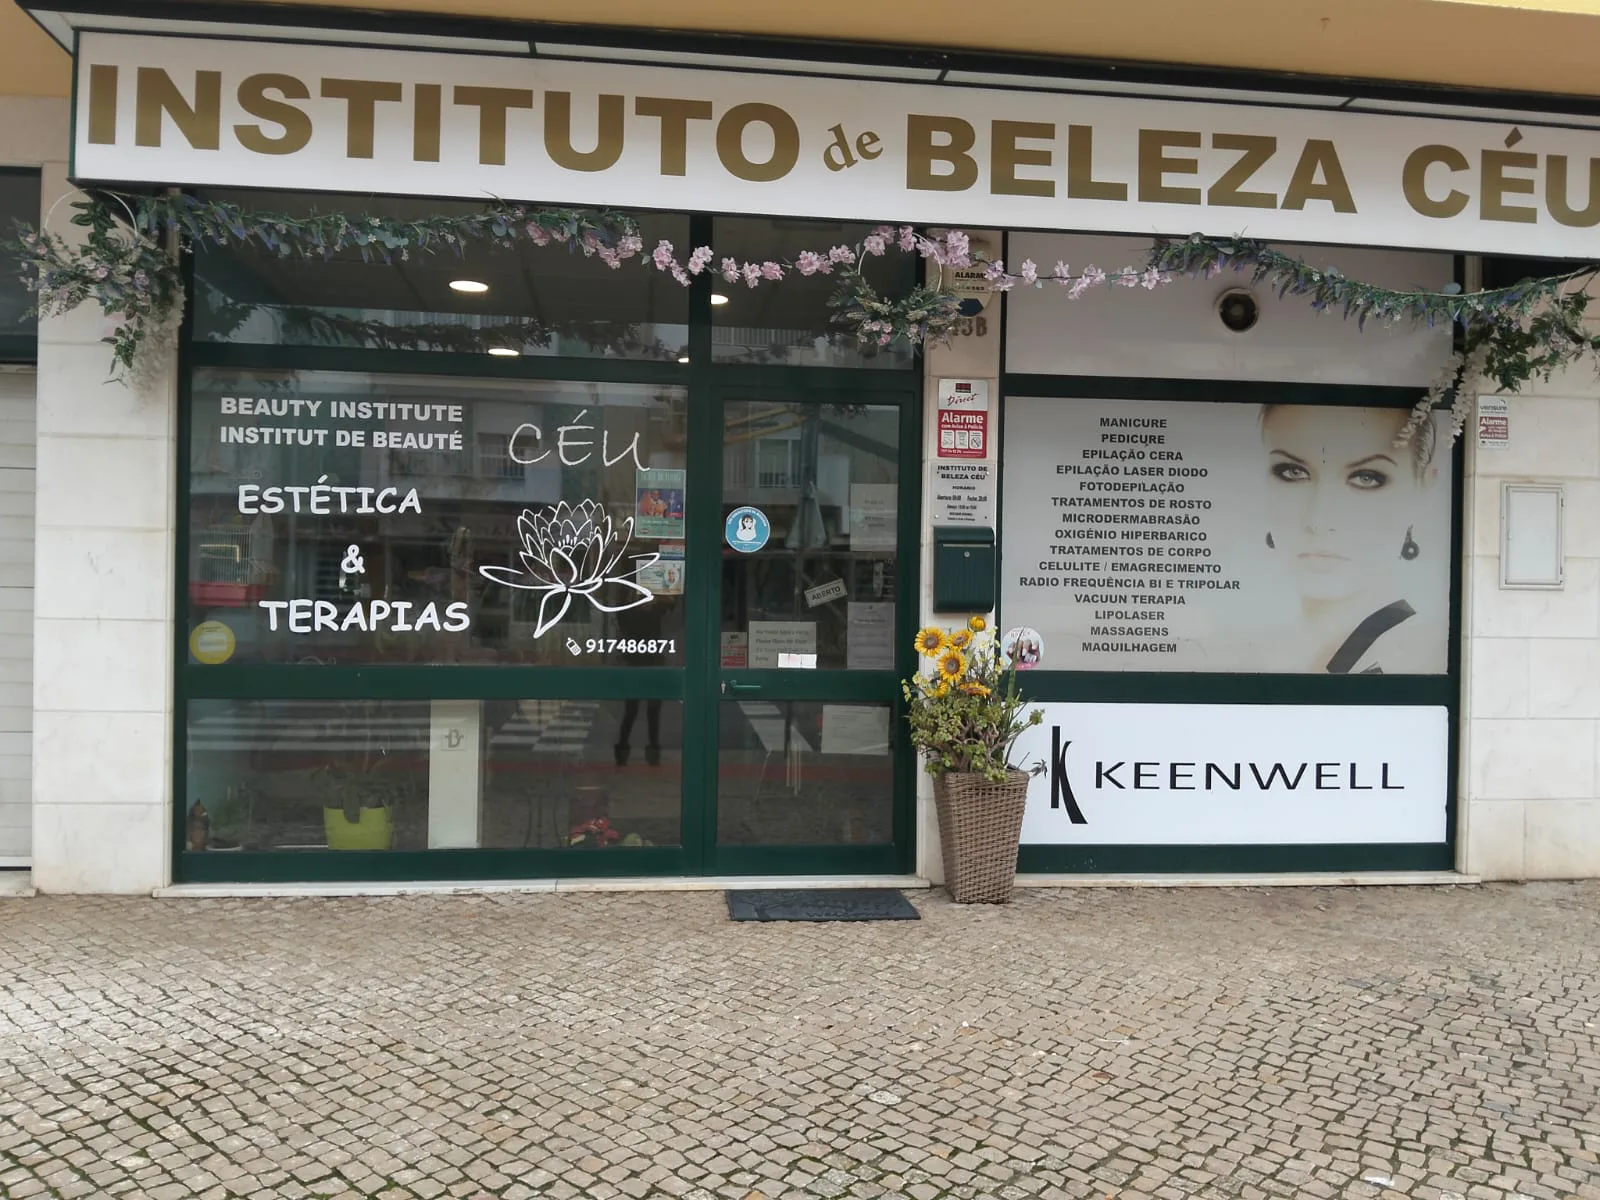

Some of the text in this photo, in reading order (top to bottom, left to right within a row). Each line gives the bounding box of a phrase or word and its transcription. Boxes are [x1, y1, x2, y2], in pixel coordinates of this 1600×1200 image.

[87, 63, 1600, 228] INSTITUTO de BELEZA CÉU
[221, 398, 463, 422] BEAUTY INSTITUTE
[942, 412, 983, 424] Alarme
[1100, 418, 1167, 428] MANICURE
[221, 426, 463, 450] INSTITUT DE BEAUTÉ
[508, 409, 650, 471] CÉU
[1102, 434, 1165, 444] PEDICURE
[1082, 450, 1183, 462] EPILAÇÃO CERA
[1056, 465, 1208, 477] EPILAÇÃO LASER DIODO
[1080, 482, 1184, 494] FOTODEPILAÇÃO
[238, 474, 422, 515] ESTÉTICA
[1052, 497, 1211, 509] TRATAMENTOS DE ROSTO
[1062, 513, 1200, 525] MICRODERMABRASÃO
[1055, 528, 1207, 541] OXIGÉNIO HIPERBARICO
[1050, 545, 1211, 557] TRATAMENTOS DE CORPO
[341, 545, 366, 574] &
[1039, 561, 1221, 573] CELULITE / EMAGRECIMENTO
[1020, 577, 1240, 590] RADIO FREQUÊNCIA BI E TRIPOLAR
[812, 586, 841, 601] ABERTO
[1075, 594, 1185, 605] VACUUN TERAPIA
[259, 599, 470, 633] TERAPIAS
[1095, 610, 1164, 621] LIPOLASER
[1090, 626, 1169, 636] MASSAGENS
[586, 638, 676, 654] 917486871
[1082, 642, 1177, 653] MAQUILHAGEM
[1095, 761, 1405, 790] KEENWELL
